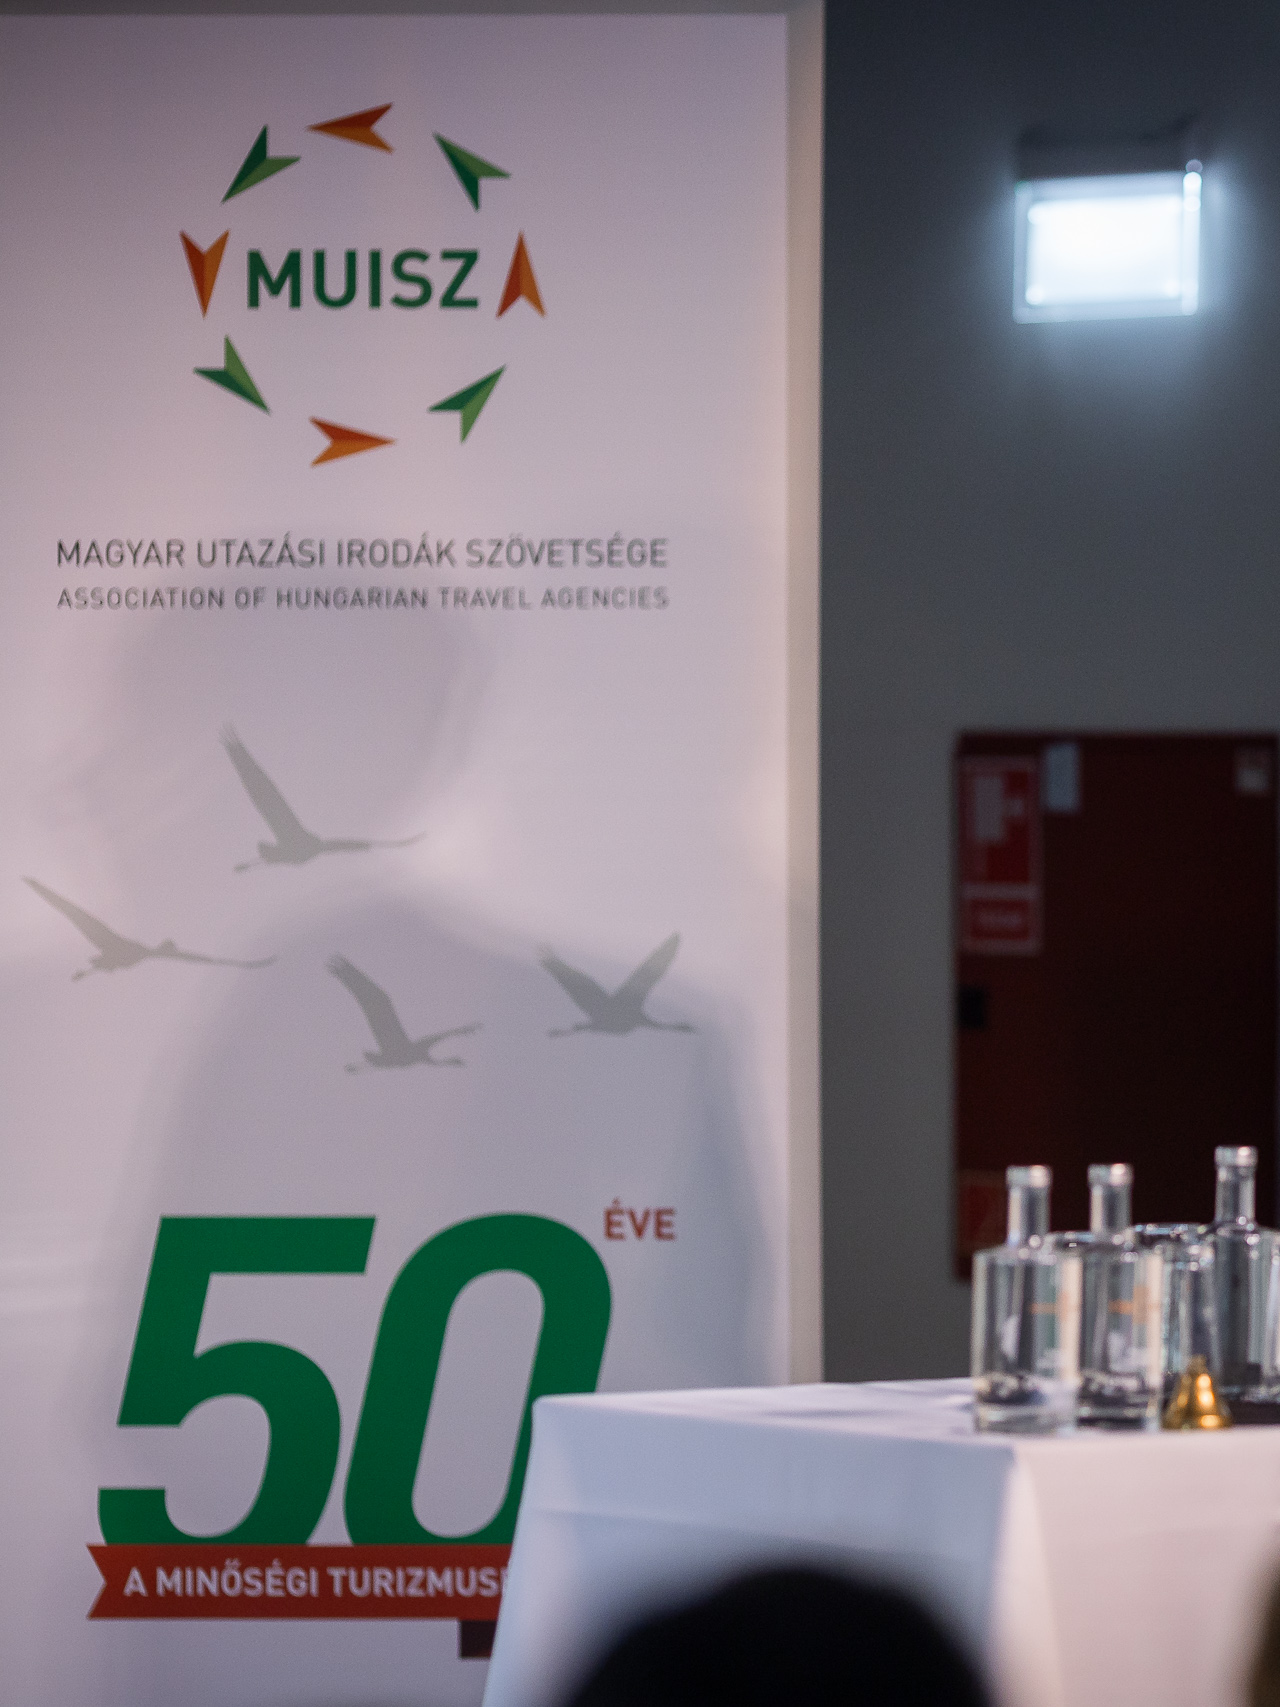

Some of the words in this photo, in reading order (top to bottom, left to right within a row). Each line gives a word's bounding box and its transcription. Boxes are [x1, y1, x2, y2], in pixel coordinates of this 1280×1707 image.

[247, 248, 480, 310] MUISZ
[57, 538, 186, 568] MAGYAR
[196, 532, 327, 569] UTAZÁSI
[336, 532, 457, 569] IRODÁK
[466, 532, 669, 569] SZÖVETSÉGE
[57, 586, 226, 610] ASSOCIATION
[234, 586, 266, 610] OF
[276, 586, 429, 610] HUNGARIAN
[439, 586, 530, 610] TRAVEL
[540, 586, 670, 610] AGENCIES
[97, 1212, 612, 1546] 50
[604, 1198, 677, 1241] ÉVE
[123, 1566, 149, 1598] A
[155, 1557, 320, 1598] MINŐSÉGI
[326, 1566, 508, 1598] TURIZMUS
